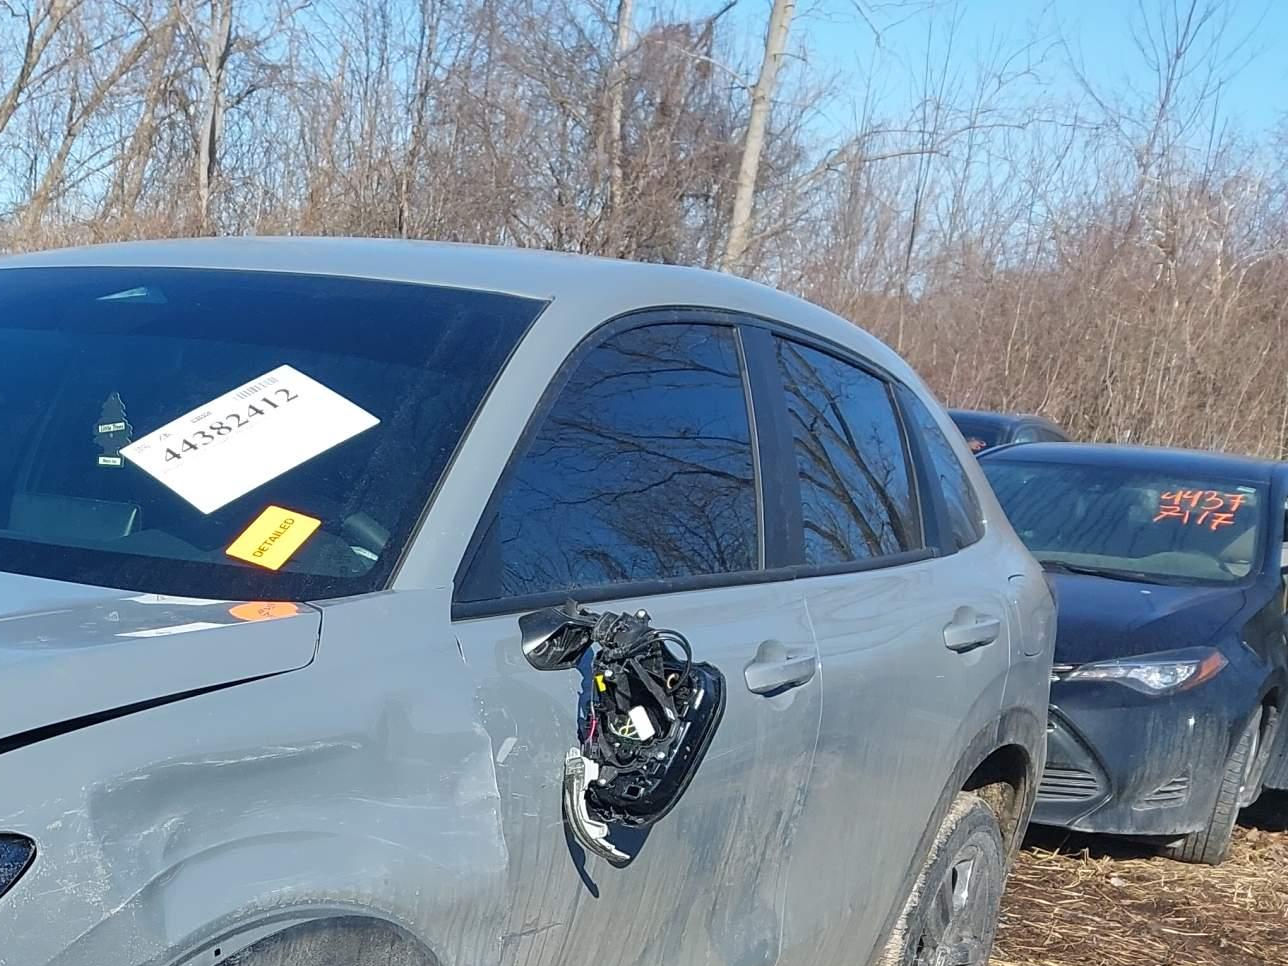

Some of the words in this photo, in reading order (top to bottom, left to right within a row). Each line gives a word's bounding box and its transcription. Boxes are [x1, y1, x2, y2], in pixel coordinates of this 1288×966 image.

[164, 387, 299, 464] 44382412
[1161, 489, 1246, 512] 4437
[252, 518, 295, 558] DETAILED
